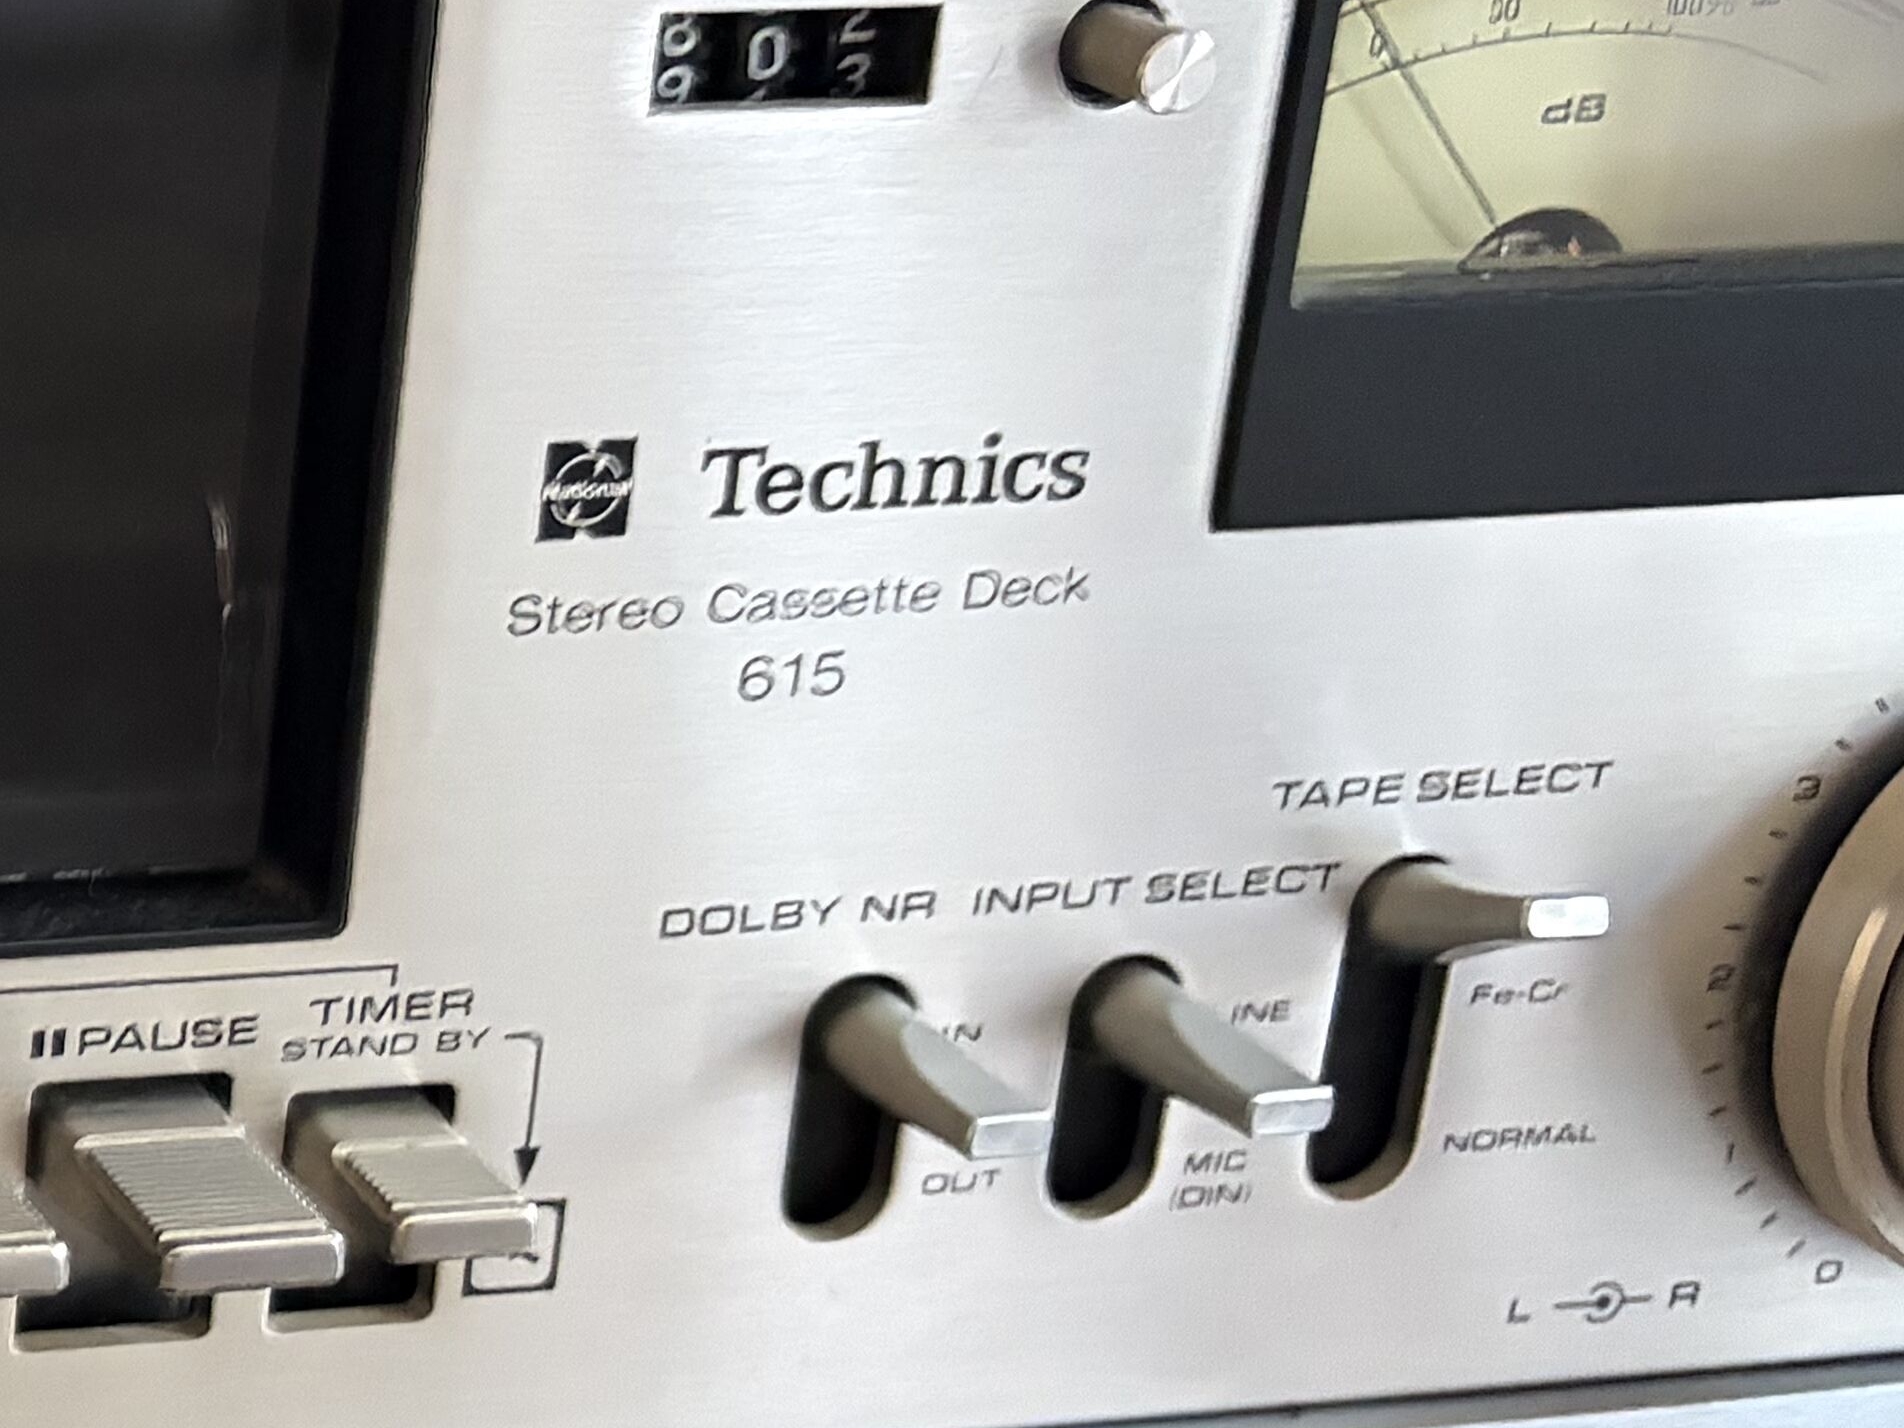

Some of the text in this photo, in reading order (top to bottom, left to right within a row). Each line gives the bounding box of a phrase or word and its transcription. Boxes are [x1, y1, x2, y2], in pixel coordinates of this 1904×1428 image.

[1542, 92, 1608, 124] dB
[702, 434, 1092, 518] Technics
[506, 564, 1092, 638] Stereo Cassette Deck
[735, 650, 848, 704] 615
[1272, 760, 1612, 812] TAPE SELECT
[972, 862, 1342, 918] INPUT SELECT
[658, 890, 936, 940] DOLBY NR
[310, 986, 474, 1026] TIMER
[1230, 998, 1292, 1024] INE
[76, 1014, 260, 1056] PAUSE
[282, 1028, 492, 1062] STAND BY
[1442, 1126, 1598, 1154] NORMAL
[1182, 1150, 1248, 1176] MIC
[920, 1166, 1002, 1198] OUT
[1506, 1300, 1528, 1324] L
[1670, 1282, 1702, 1308] R
